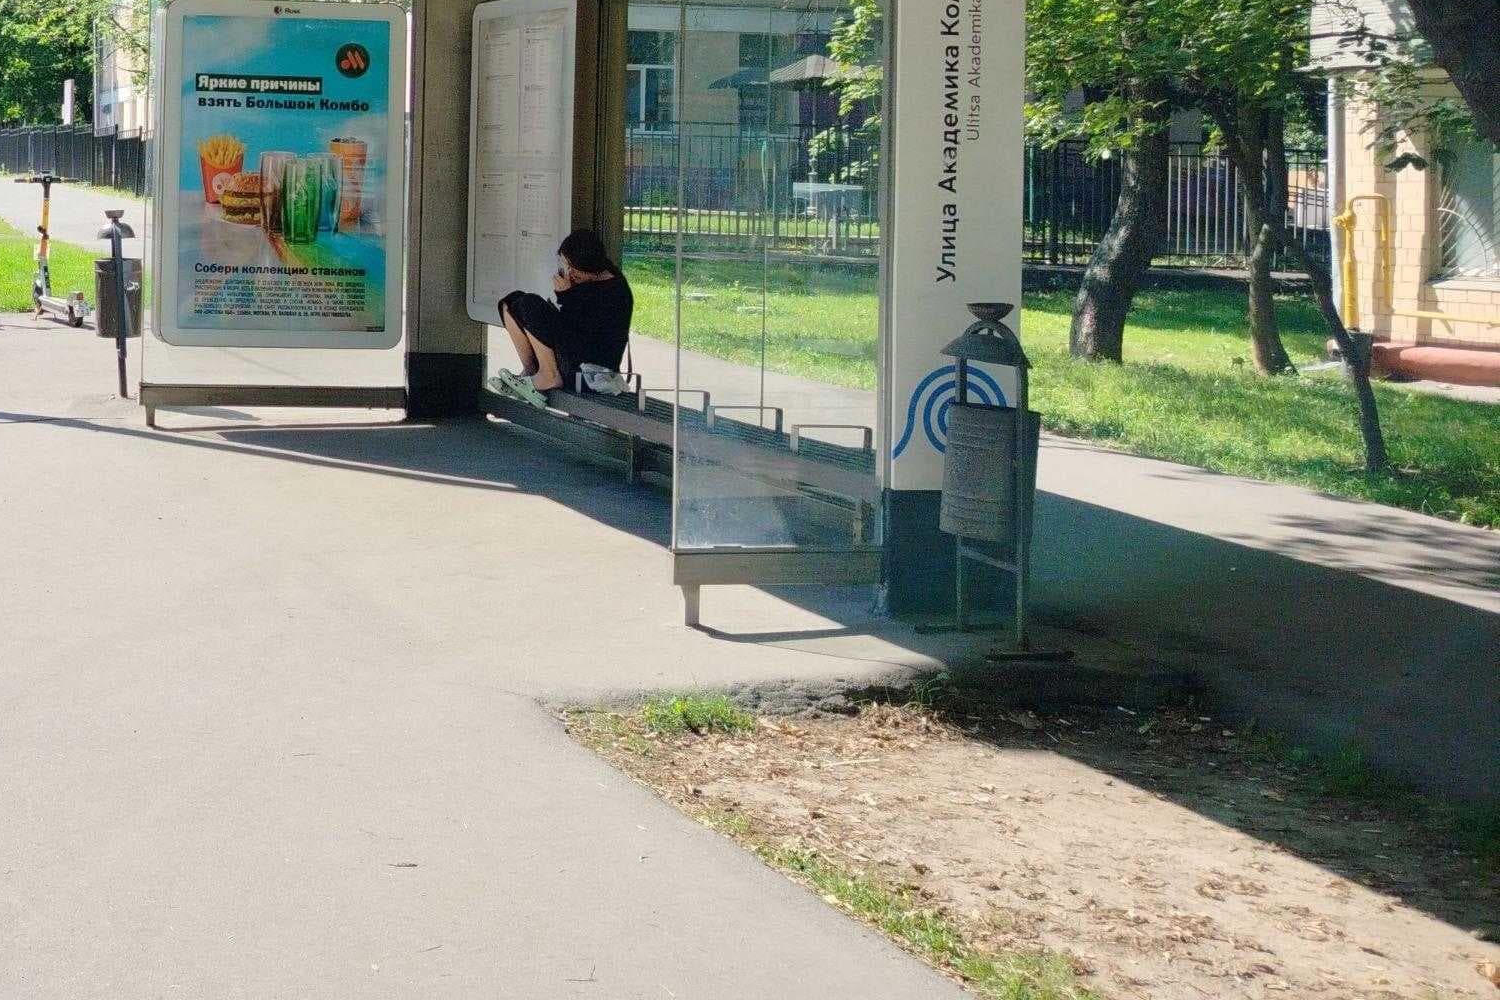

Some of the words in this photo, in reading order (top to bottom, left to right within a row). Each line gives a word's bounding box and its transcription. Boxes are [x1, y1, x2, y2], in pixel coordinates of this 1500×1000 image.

[198, 75, 247, 90] Яркие
[251, 78, 320, 92] причины
[198, 97, 242, 108] взять
[246, 95, 315, 110] Большой
[320, 99, 370, 112] Комбо
[938, 45, 961, 193] Академика
[966, 95, 981, 141] Ulitsa
[936, 203, 959, 282] Улица
[194, 262, 239, 275] Собери
[242, 264, 308, 277] коллекцию
[311, 267, 366, 277] стаканов
